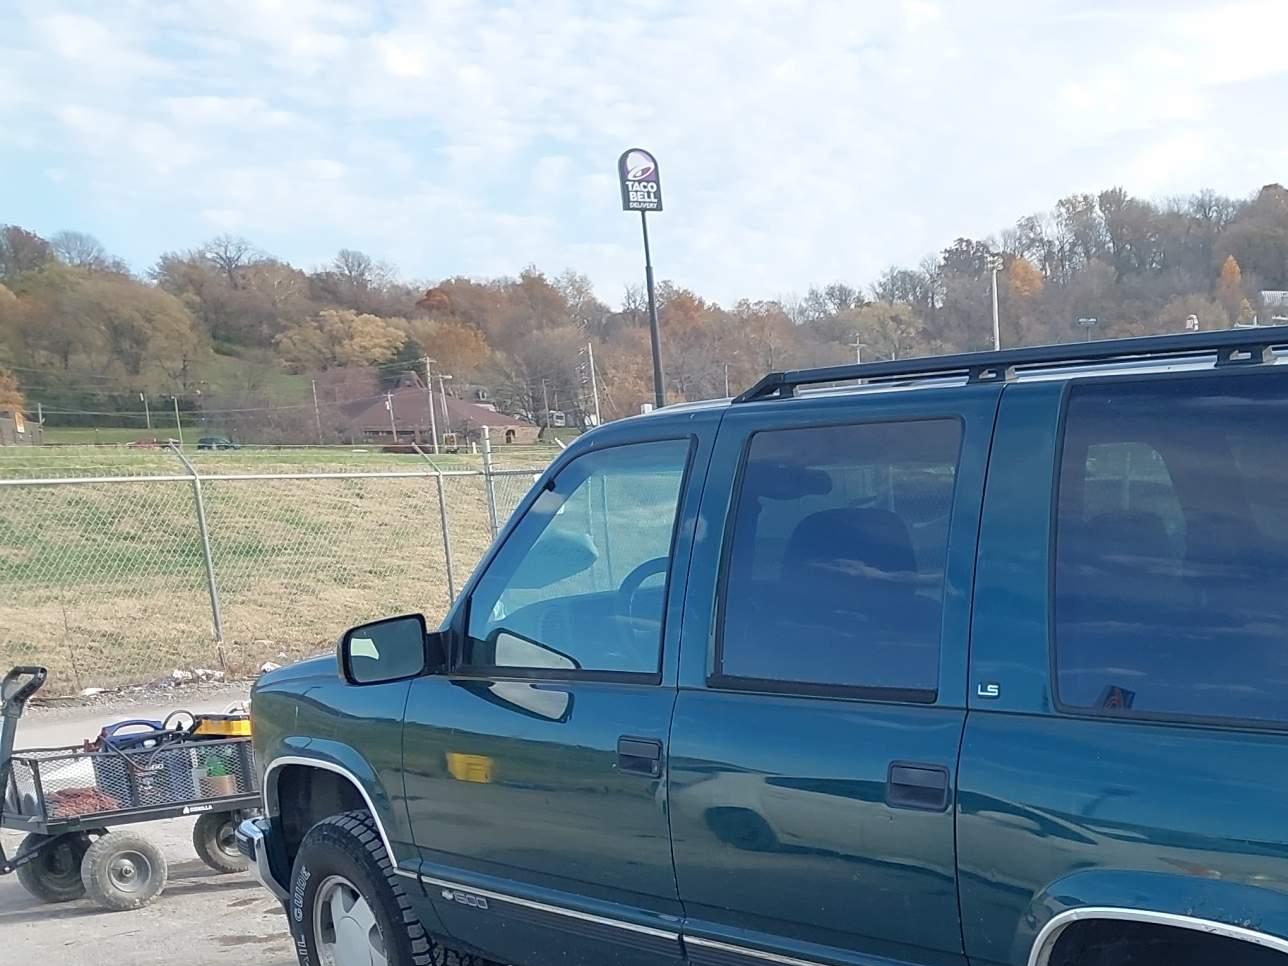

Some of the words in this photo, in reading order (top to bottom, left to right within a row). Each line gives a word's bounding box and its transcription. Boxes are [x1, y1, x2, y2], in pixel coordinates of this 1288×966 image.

[626, 182, 657, 192] TACO
[630, 192, 657, 202] BELL
[978, 684, 998, 696] LS
